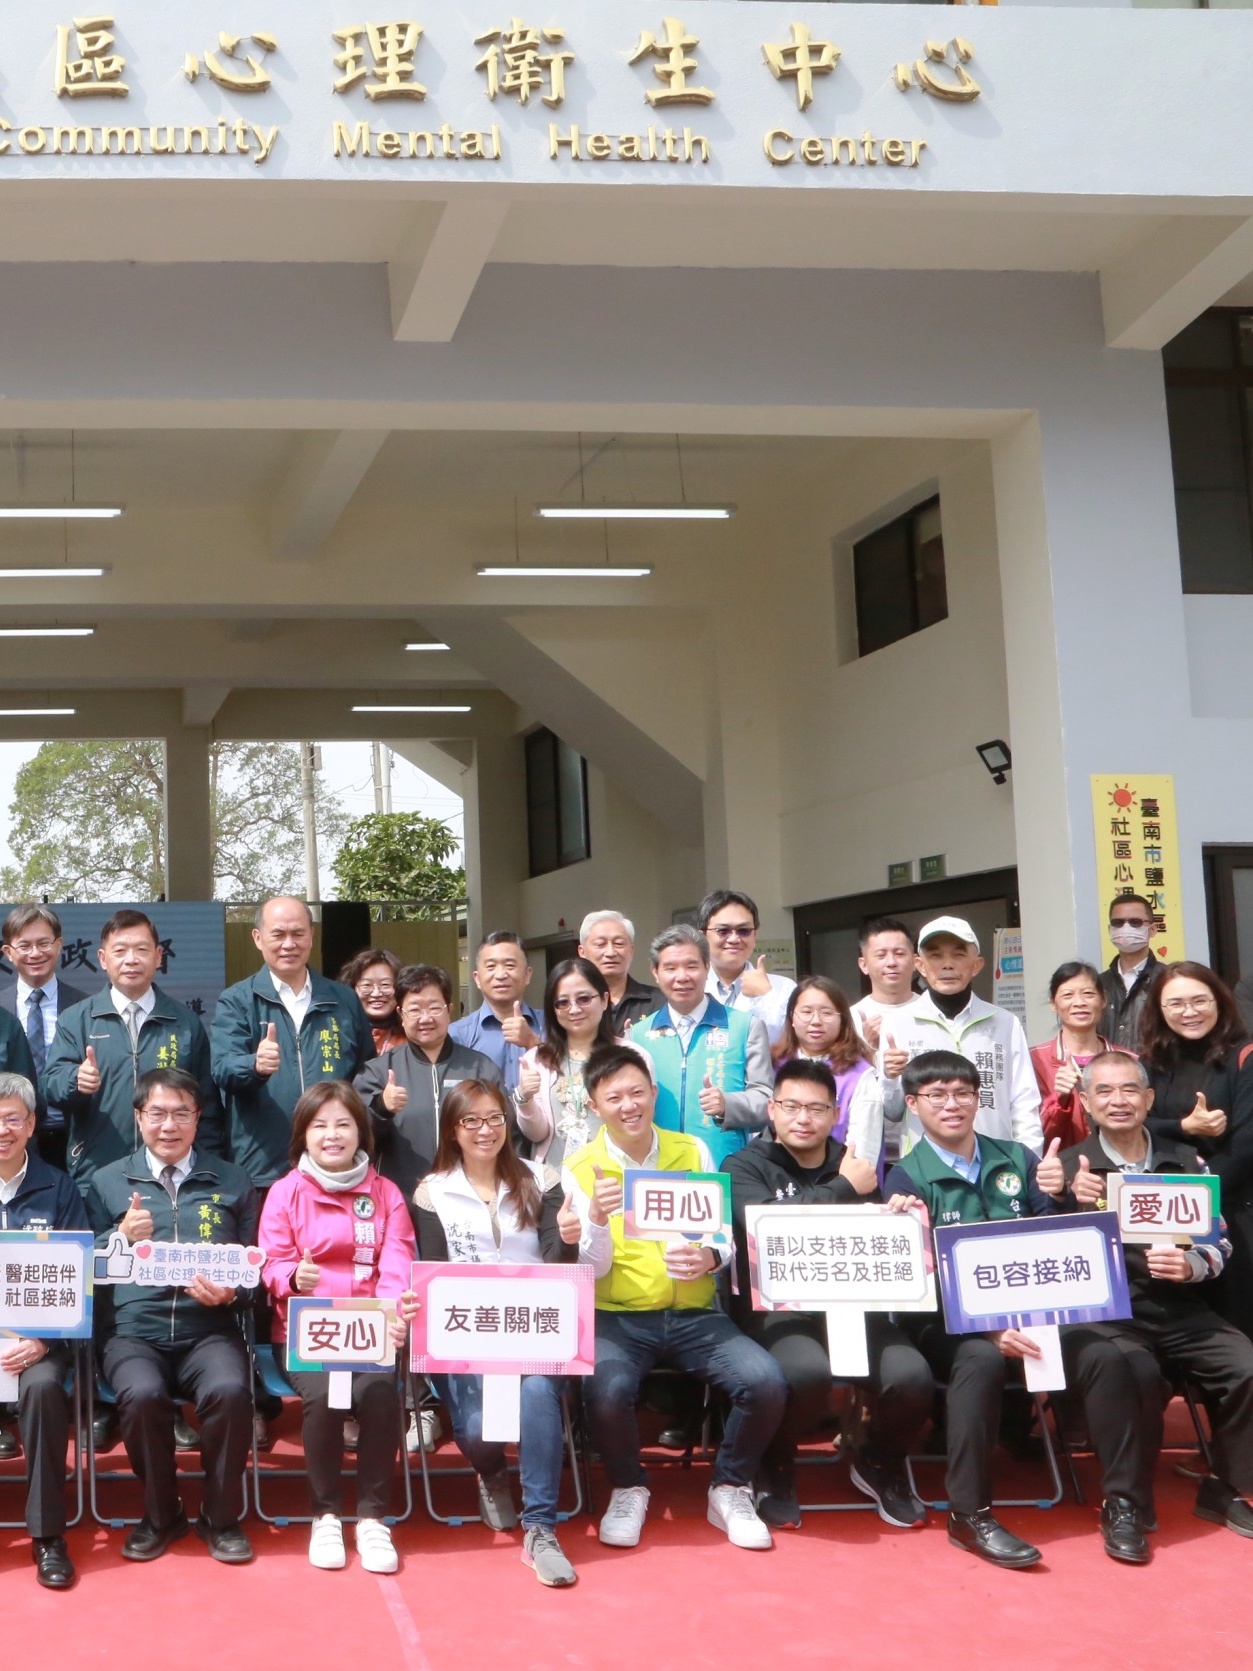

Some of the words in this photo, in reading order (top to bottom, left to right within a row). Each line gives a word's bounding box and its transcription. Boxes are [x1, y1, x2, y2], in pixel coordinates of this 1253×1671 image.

[332, 120, 501, 160] Mental
[549, 121, 711, 164] Health
[762, 129, 928, 168] Center
[1140, 798, 1167, 933] 臺南市鹽水區
[319, 1029, 333, 1072] 廖宗山
[974, 1051, 995, 1110] 賴惠員
[643, 1189, 713, 1222] 用心
[1129, 1193, 1201, 1226] 愛心
[198, 1204, 212, 1244] 黃偉
[153, 1248, 241, 1265] 臺南市鹽水區
[447, 1223, 466, 1262] 沈家
[766, 1235, 911, 1256] 請以支持及接納
[5, 1262, 77, 1284] 醫起陪伴
[768, 1261, 914, 1283] 取代污名及拒絕
[973, 1255, 1092, 1290] 包容接納
[5, 1287, 77, 1308] 社區接納
[307, 1317, 377, 1352] 安心
[444, 1305, 560, 1335] 友善關懷
